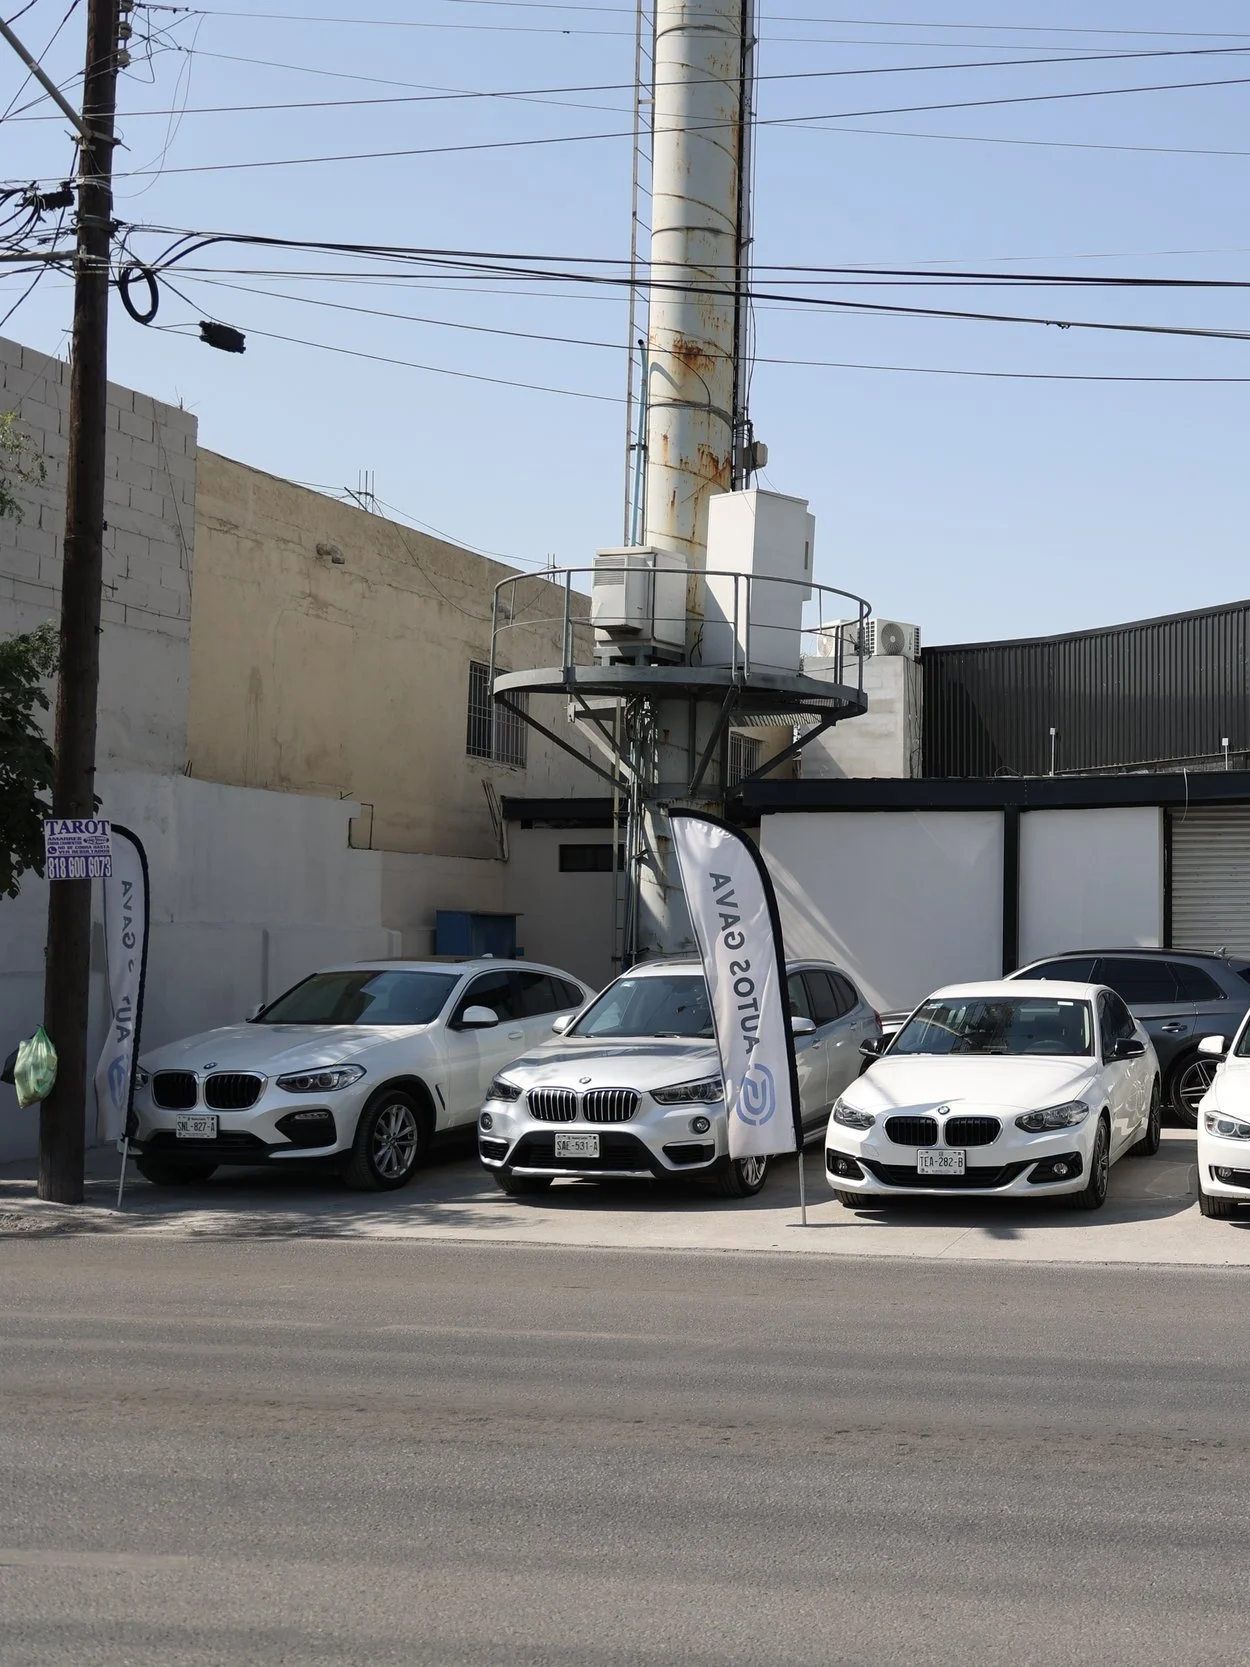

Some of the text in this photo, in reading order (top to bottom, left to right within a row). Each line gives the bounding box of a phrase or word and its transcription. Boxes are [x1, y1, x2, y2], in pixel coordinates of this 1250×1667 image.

[45, 820, 110, 836] TAROT
[48, 856, 111, 878] 818 600 6073
[556, 1140, 598, 1151] SAE-531-A
